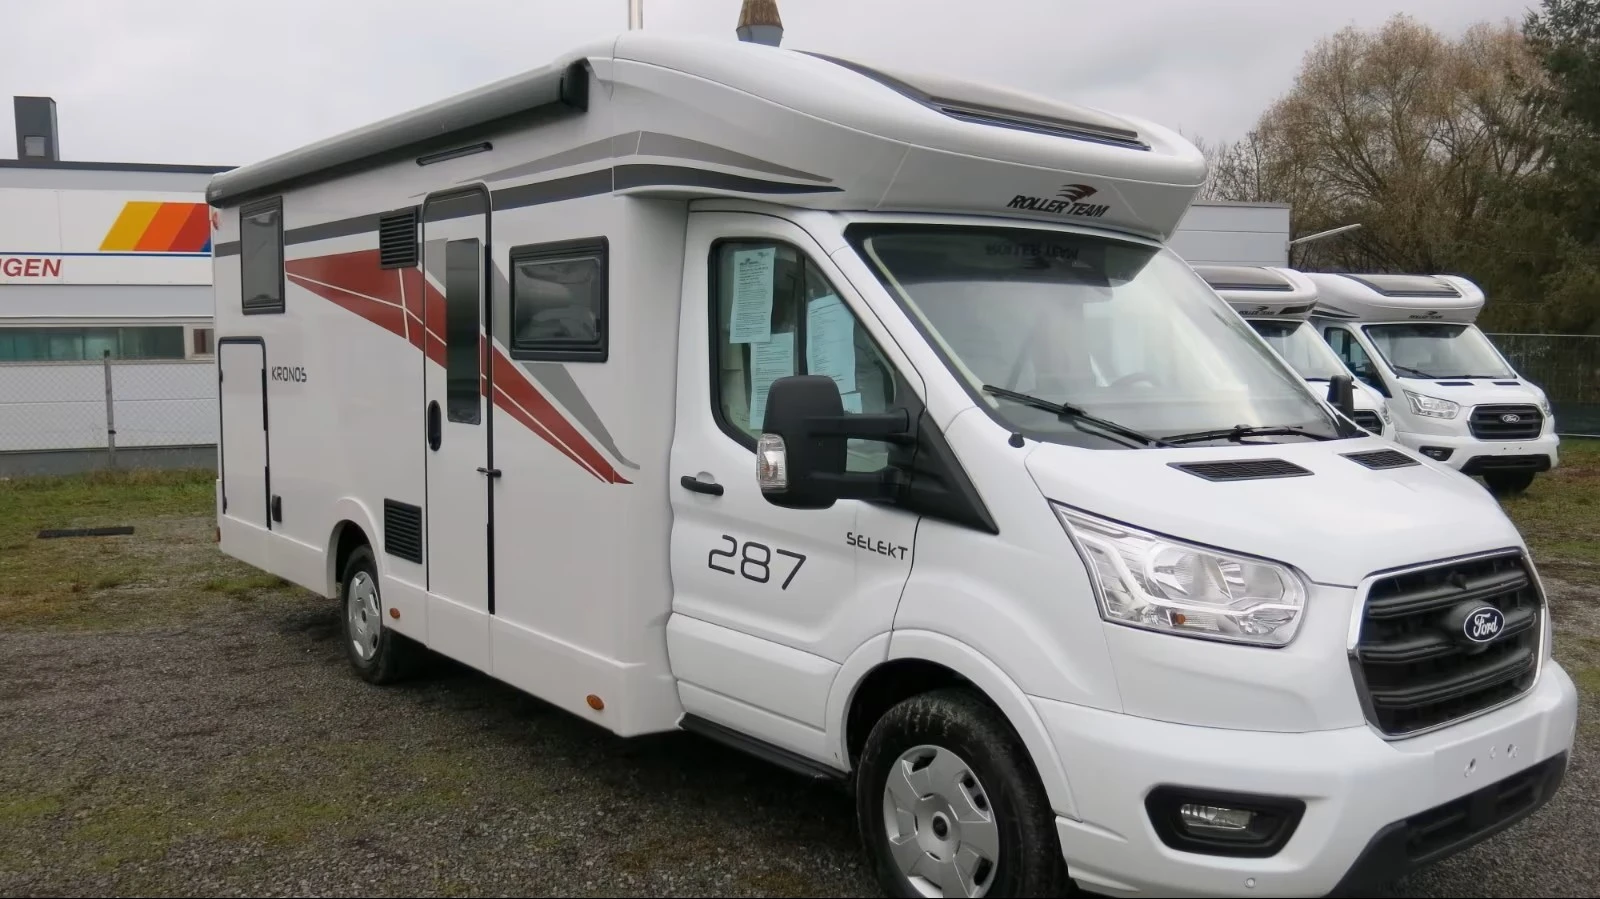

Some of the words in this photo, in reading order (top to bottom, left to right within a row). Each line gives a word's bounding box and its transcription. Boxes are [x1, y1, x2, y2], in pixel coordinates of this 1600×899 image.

[1006, 194, 1069, 214] ROLLER
[1066, 202, 1110, 218] TEAM
[0, 257, 62, 277] GEN
[271, 366, 307, 383] KRONOS
[708, 534, 807, 590] 287
[1472, 612, 1499, 637] Ford
